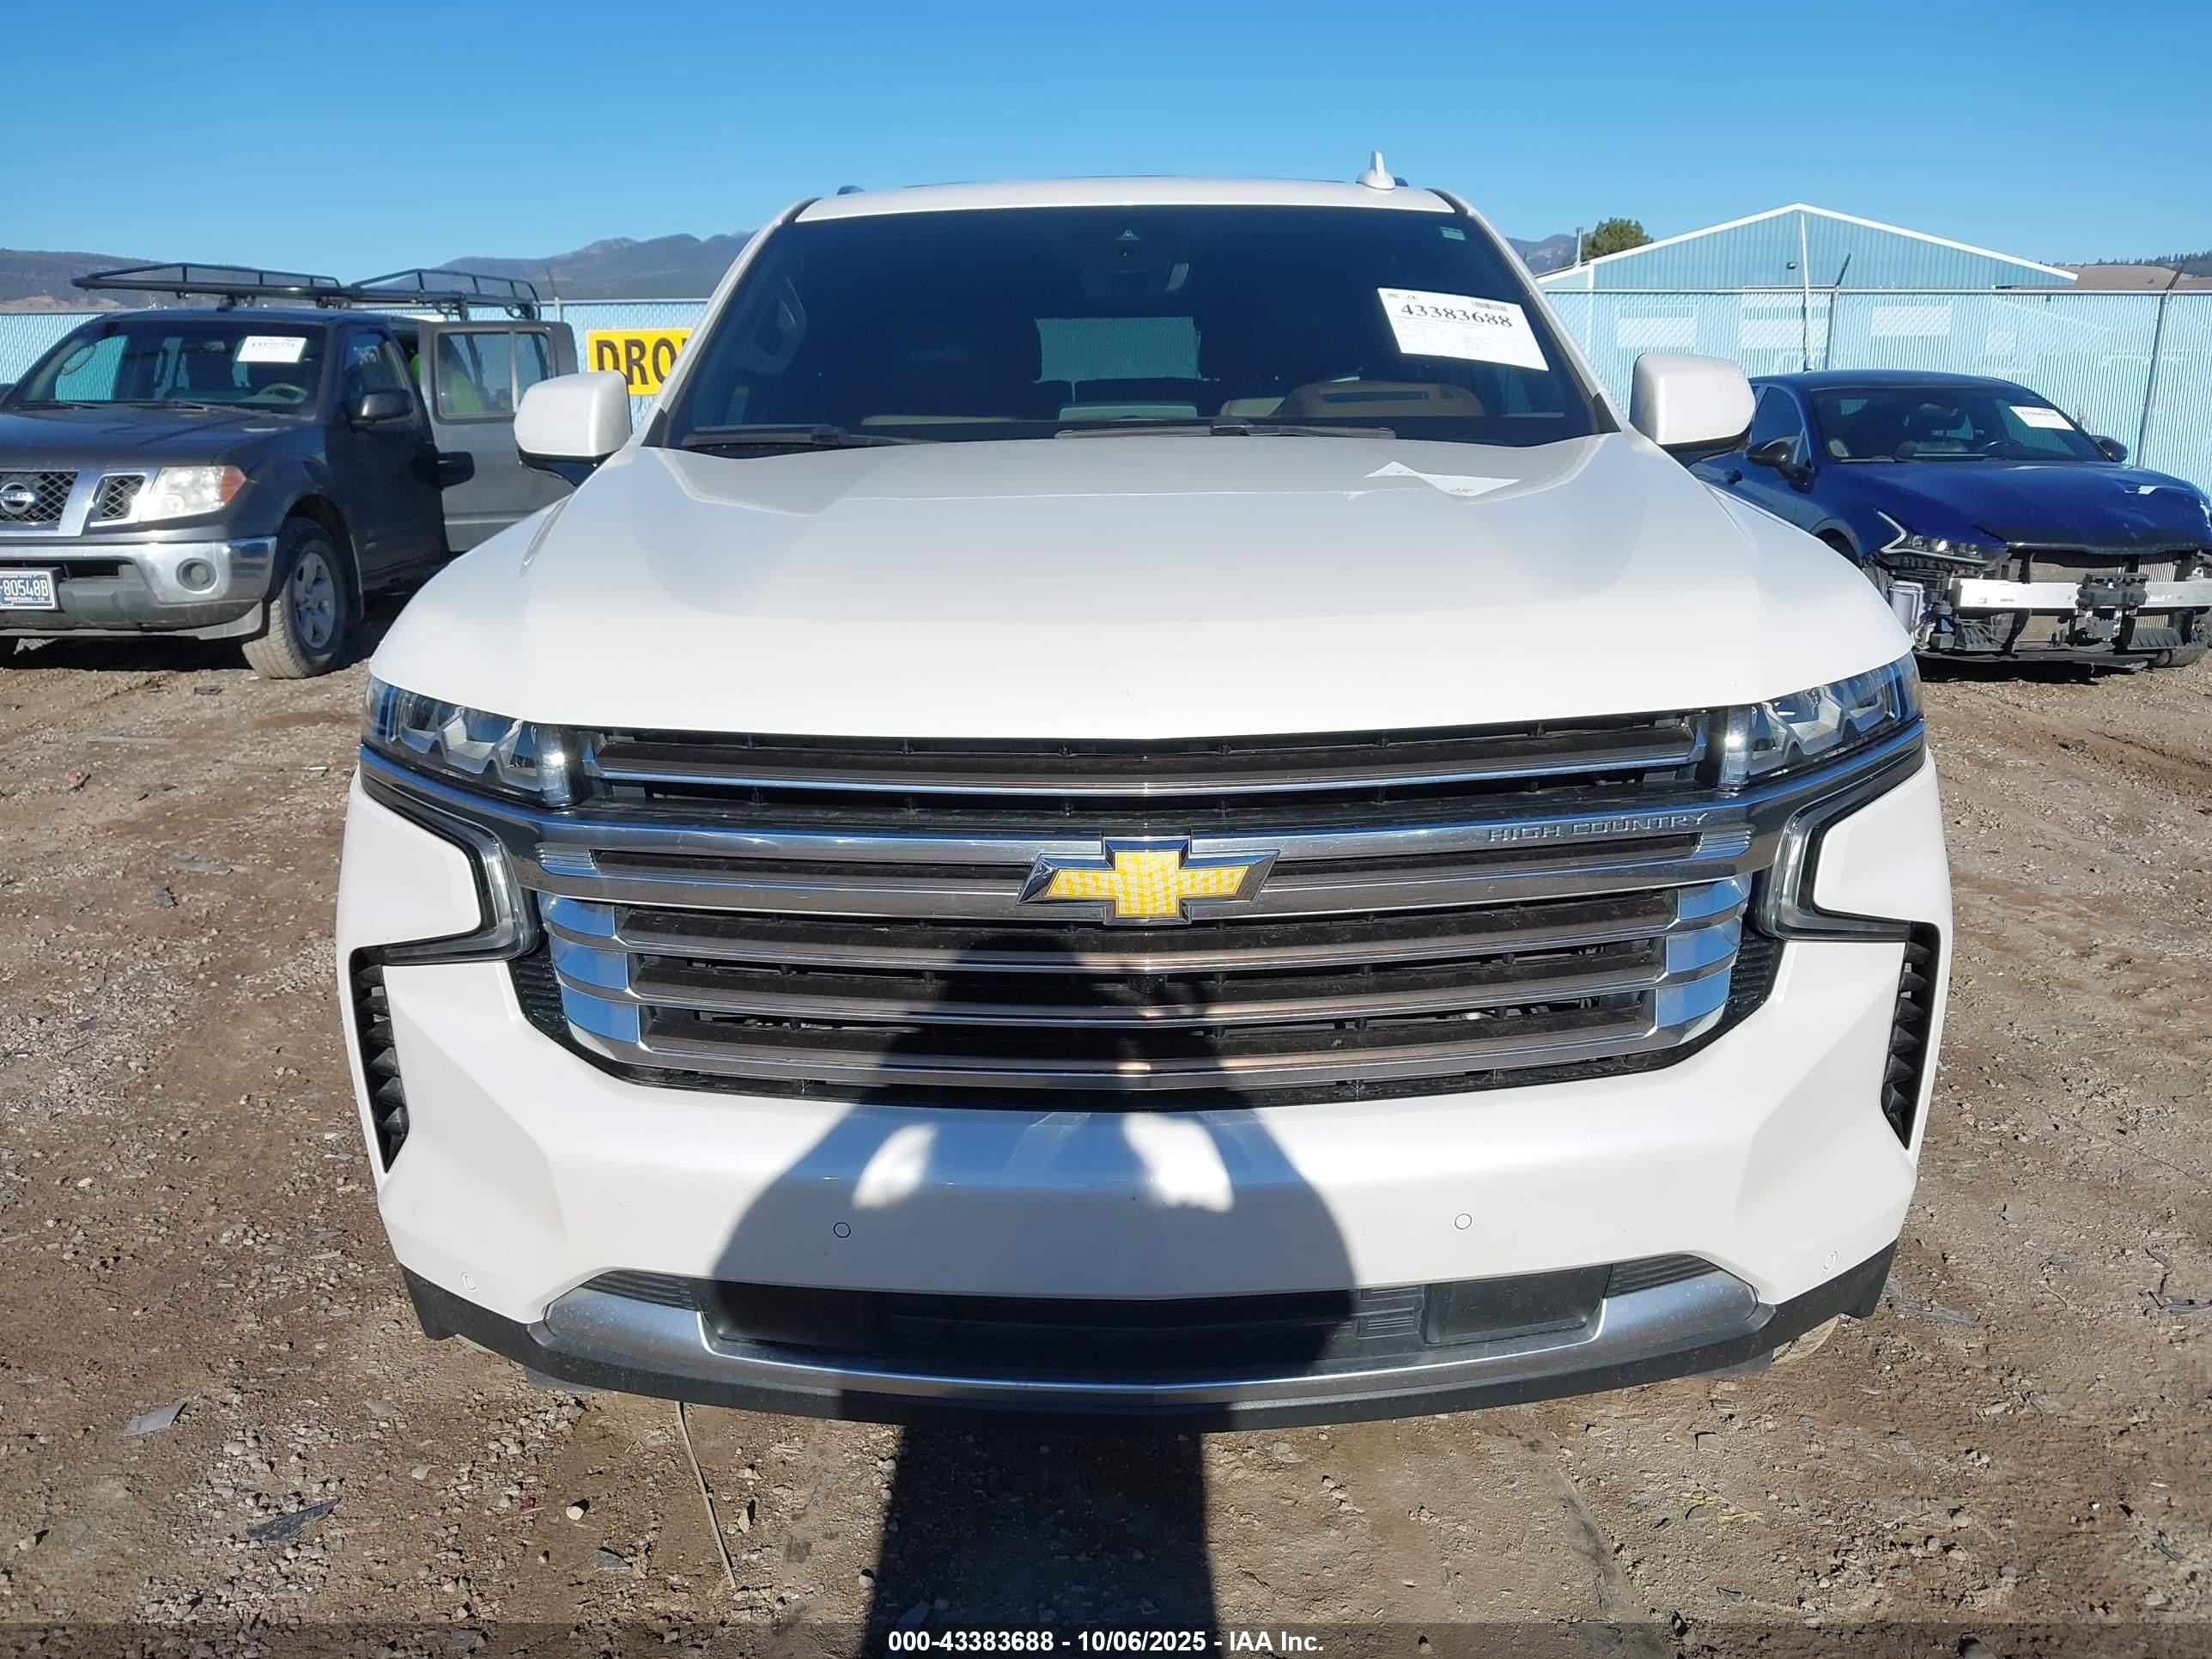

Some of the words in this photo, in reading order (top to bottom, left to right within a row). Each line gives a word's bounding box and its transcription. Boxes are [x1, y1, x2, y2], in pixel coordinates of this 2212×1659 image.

[1401, 304, 1512, 327] 43383688
[596, 337, 688, 386] DRO
[1489, 824, 1561, 842] HIGH
[1572, 812, 1709, 836] COUNTRY
